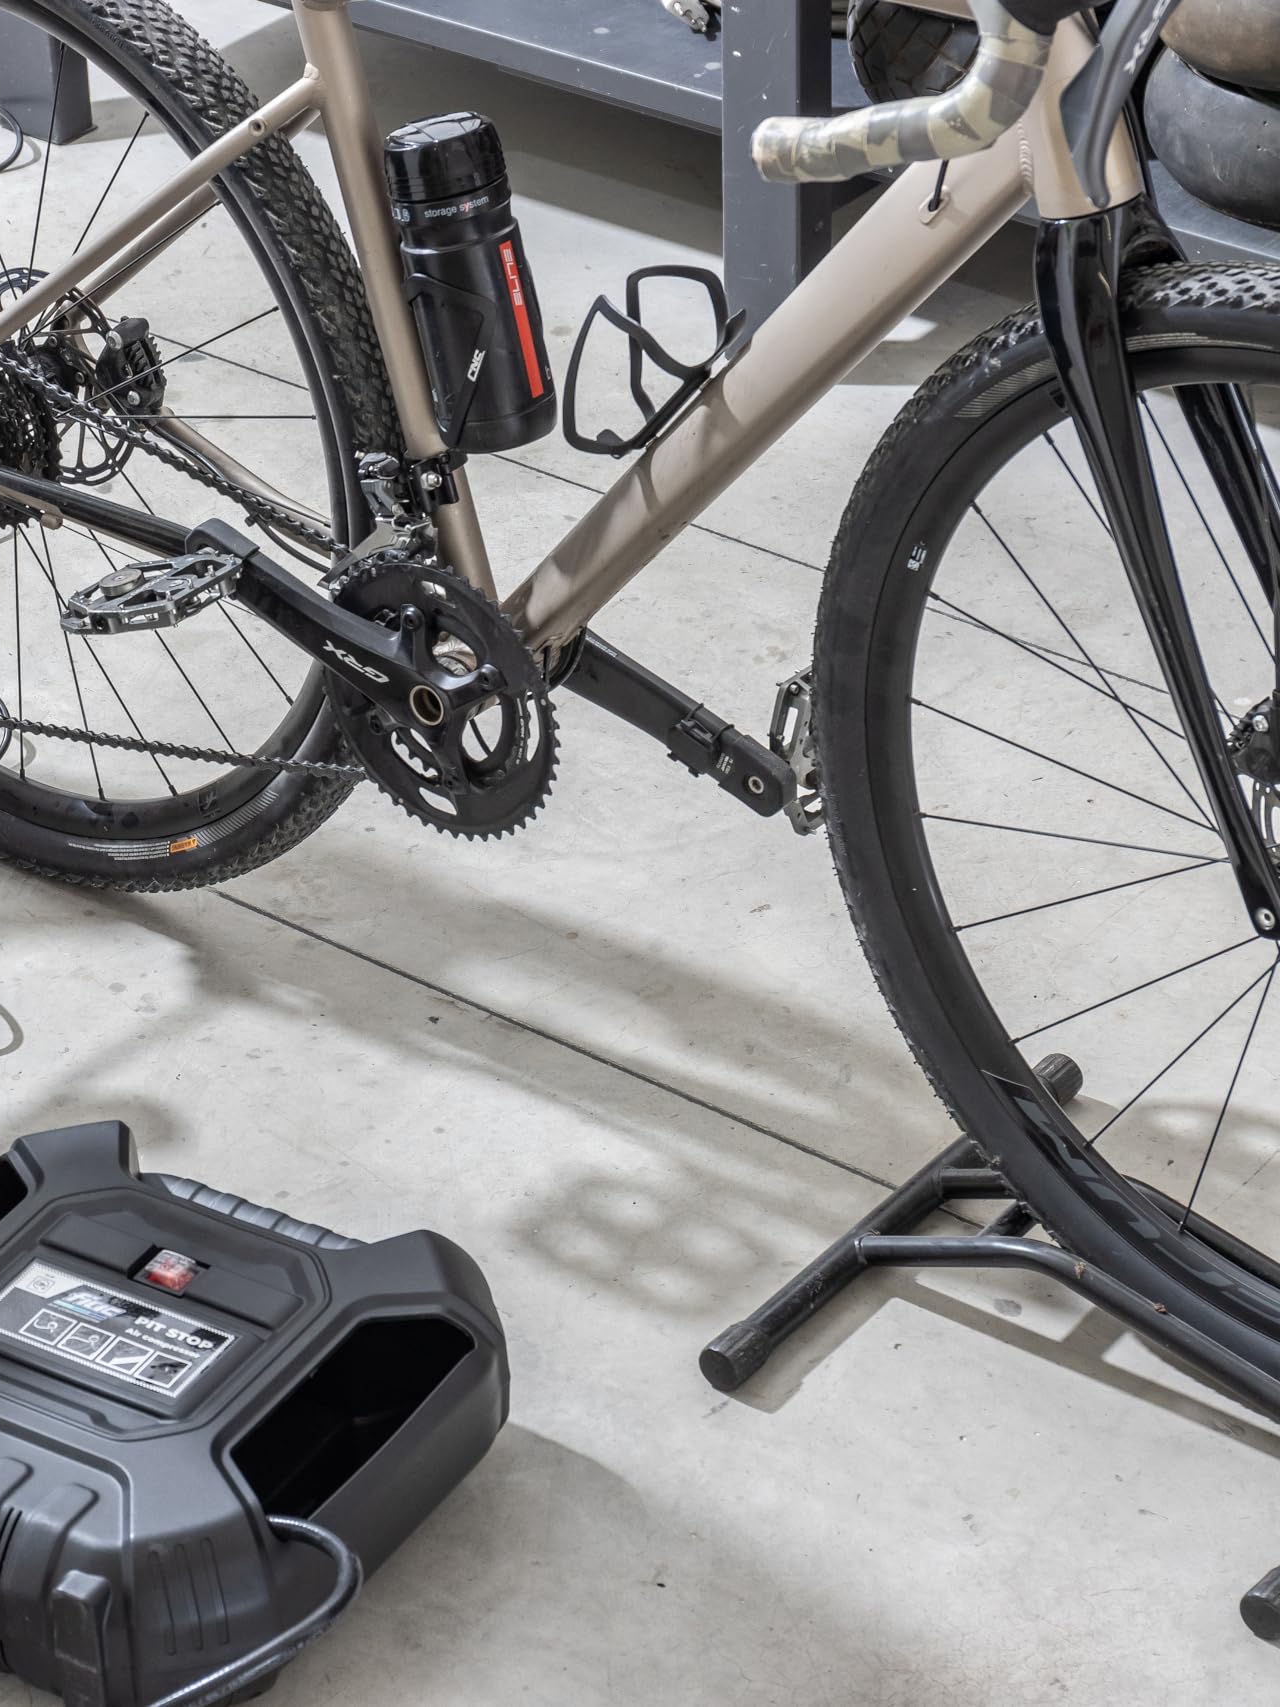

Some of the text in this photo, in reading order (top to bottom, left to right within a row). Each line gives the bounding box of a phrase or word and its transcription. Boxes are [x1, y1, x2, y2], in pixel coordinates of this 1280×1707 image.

[424, 205, 457, 218] storage
[459, 195, 489, 213] system
[467, 349, 486, 382] CNC
[322, 640, 391, 683] GRX
[124, 1327, 201, 1359] Air compressor
[134, 1316, 214, 1350] PIT STOP
